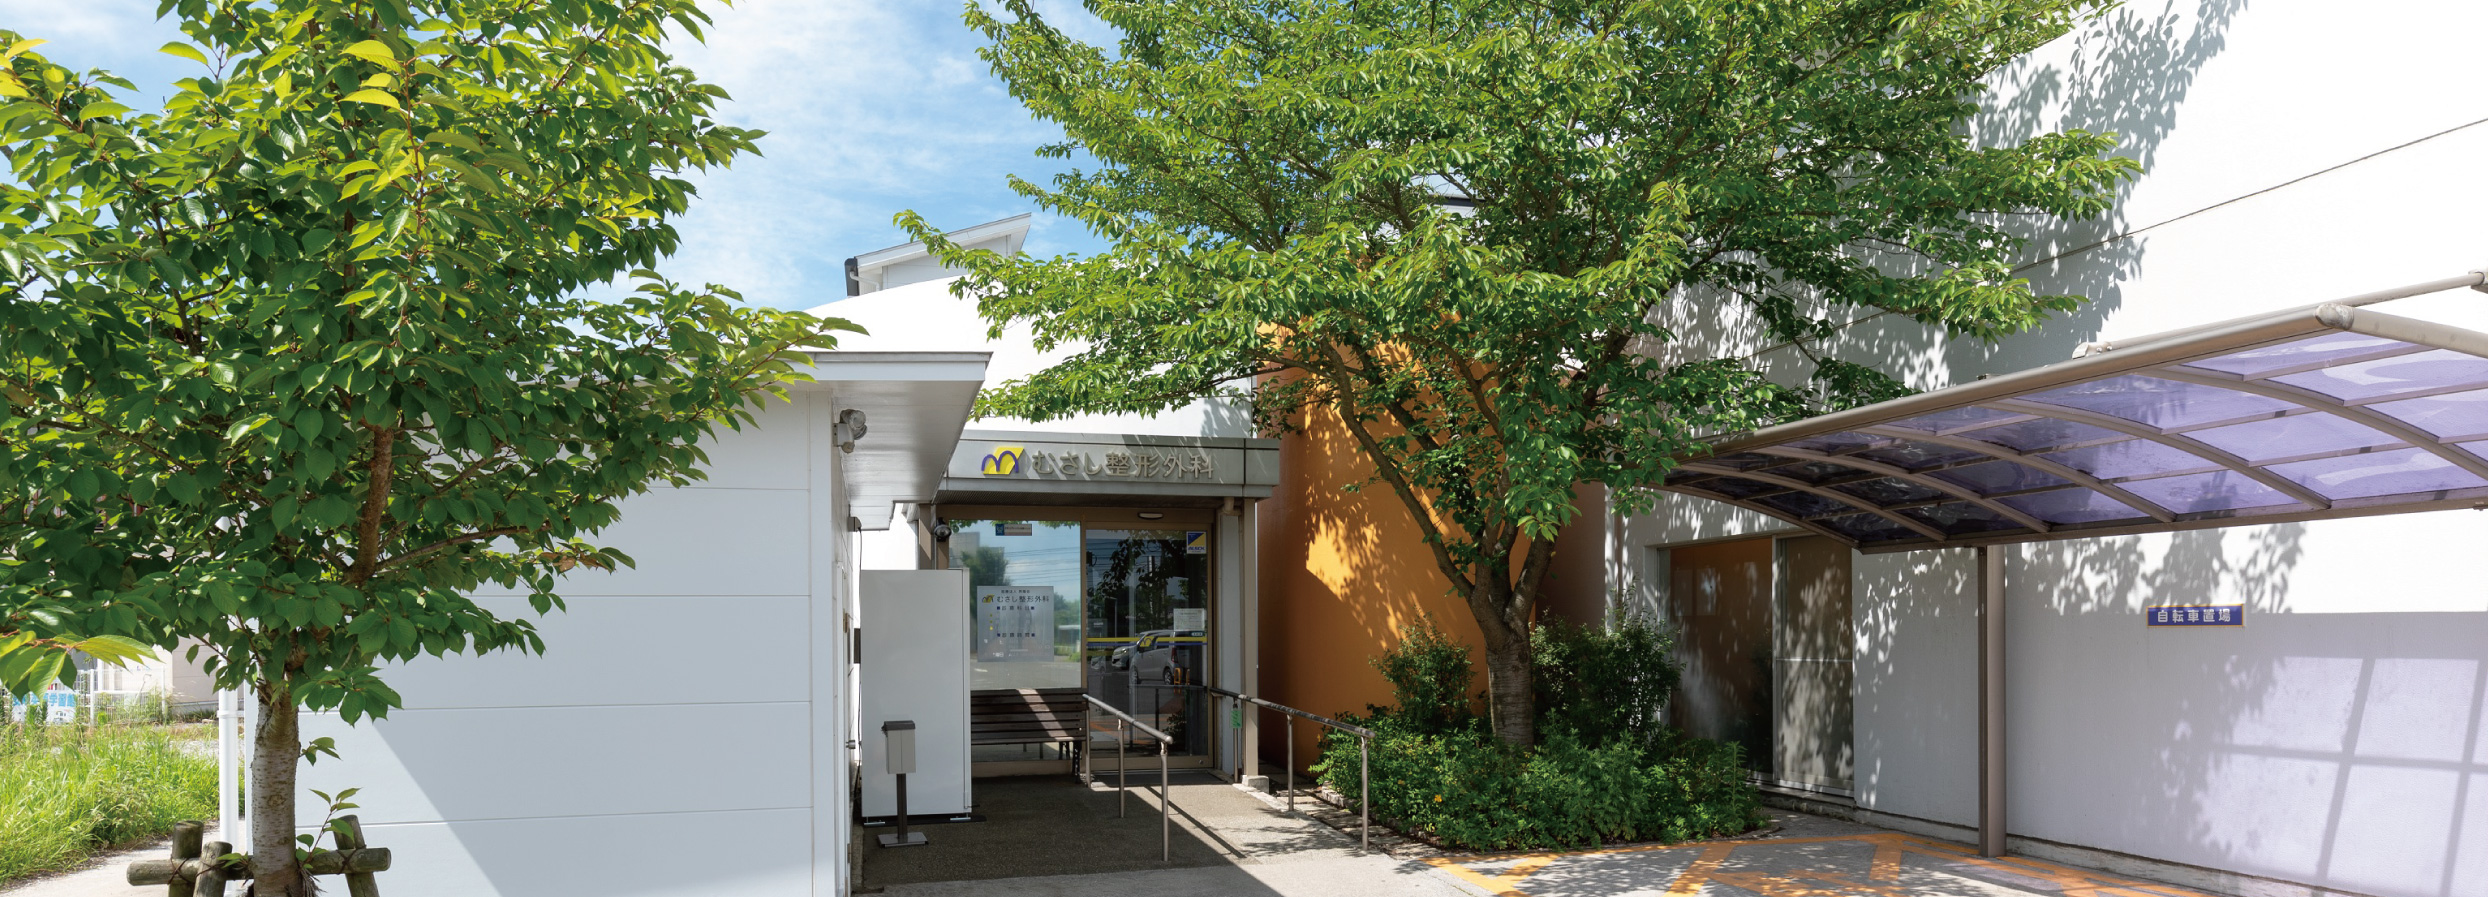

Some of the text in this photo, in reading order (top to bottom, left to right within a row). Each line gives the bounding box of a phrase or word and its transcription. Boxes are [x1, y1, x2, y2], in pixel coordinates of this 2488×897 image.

[1032, 450, 1214, 479] むさし整形外科
[997, 595, 1049, 603] むさし整形外科
[2157, 608, 2231, 623] 自転車置場
